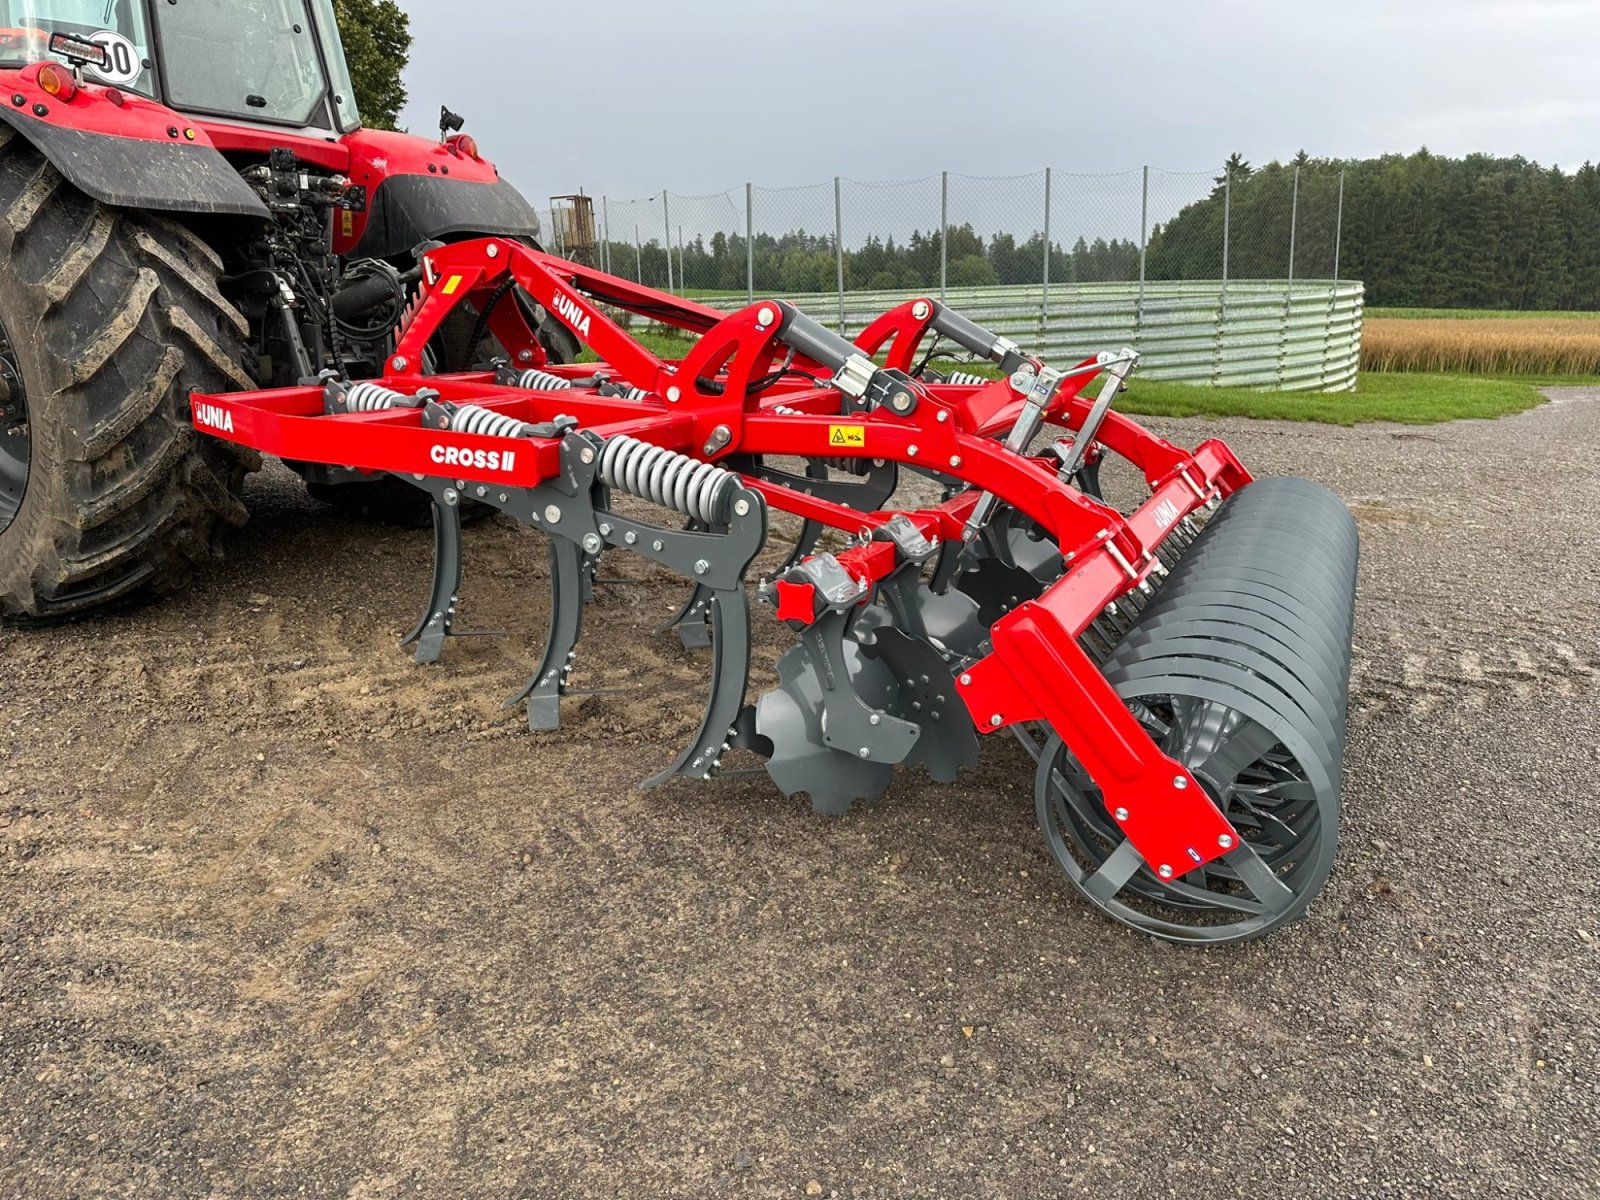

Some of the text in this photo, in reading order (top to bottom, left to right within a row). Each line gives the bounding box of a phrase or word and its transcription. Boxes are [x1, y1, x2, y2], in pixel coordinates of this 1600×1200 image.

[559, 294, 591, 337] UNIA
[202, 403, 234, 434] UNIA
[430, 444, 500, 470] CROSS
